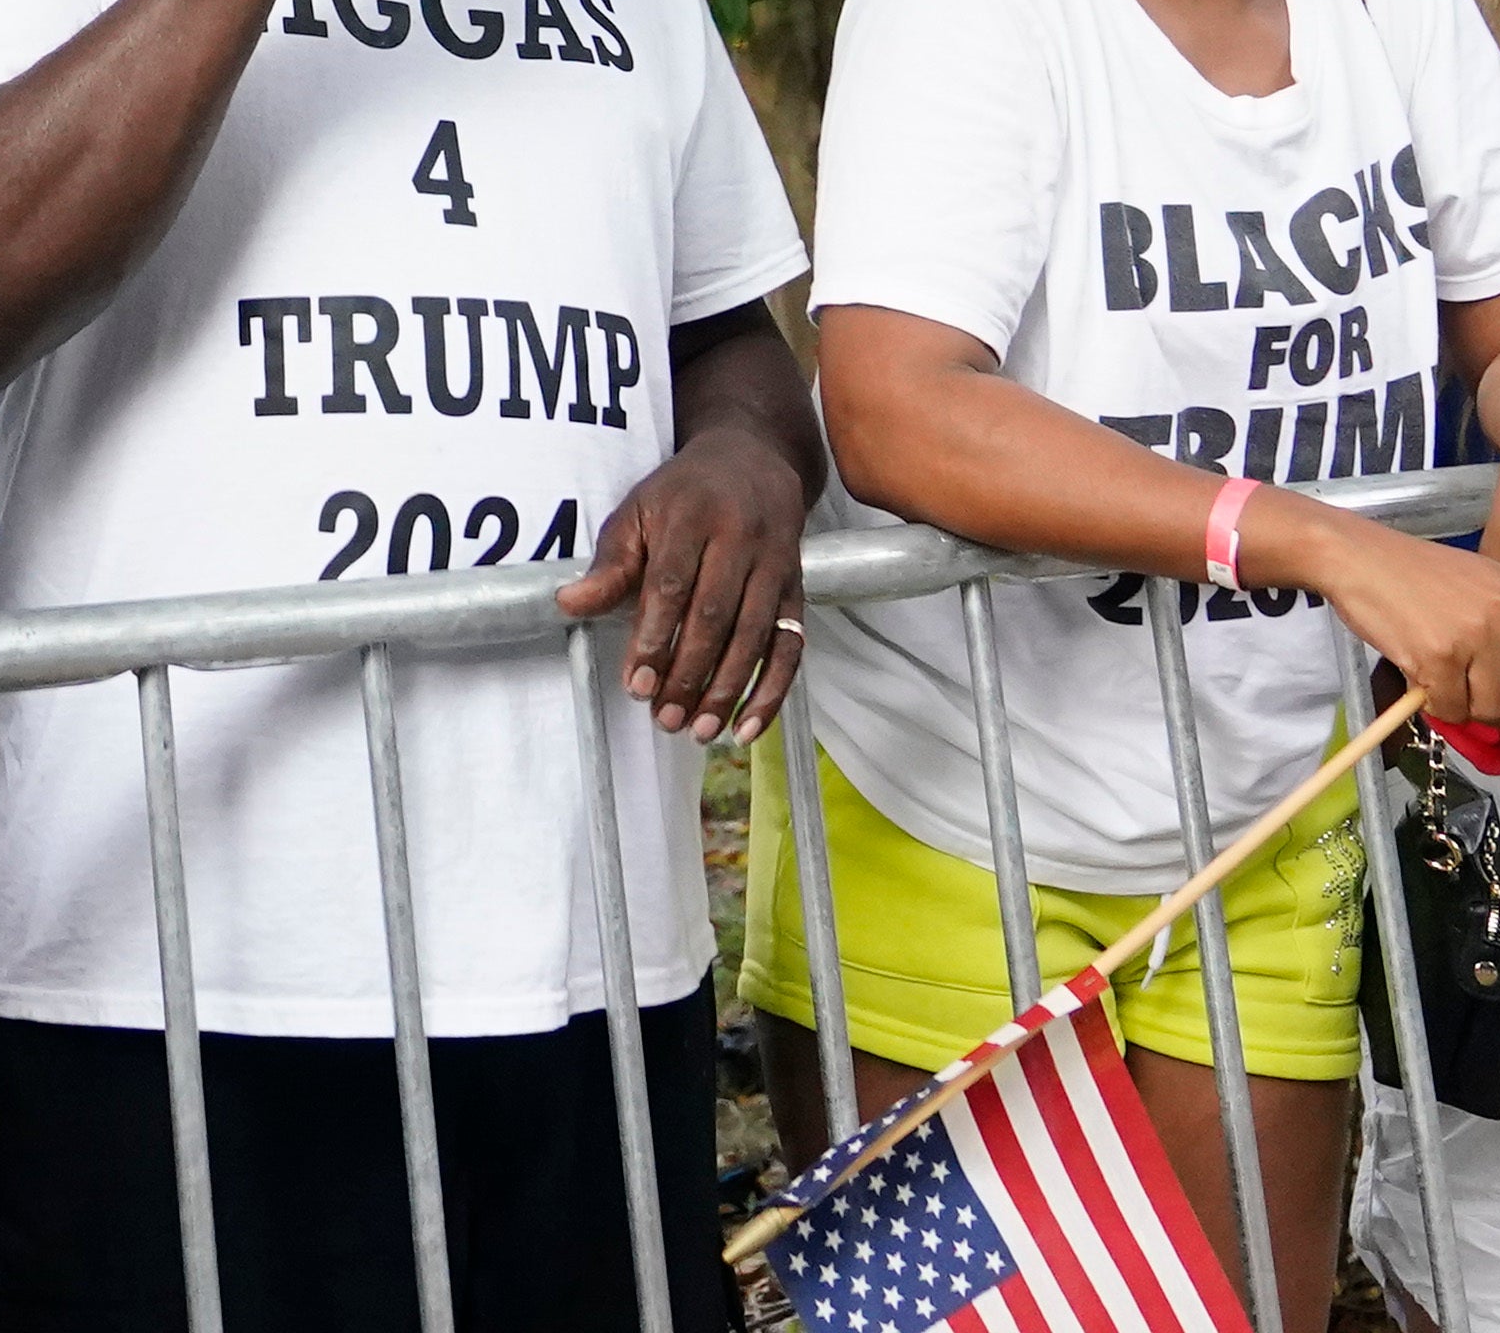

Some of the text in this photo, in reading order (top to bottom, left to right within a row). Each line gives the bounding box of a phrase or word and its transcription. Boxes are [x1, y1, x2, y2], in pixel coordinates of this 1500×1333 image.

[411, 119, 478, 227] 4
[1100, 144, 1433, 312] BLACKS
[238, 295, 641, 430] TRUMP
[1248, 306, 1373, 391] FOR
[1100, 366, 1438, 485] RUM
